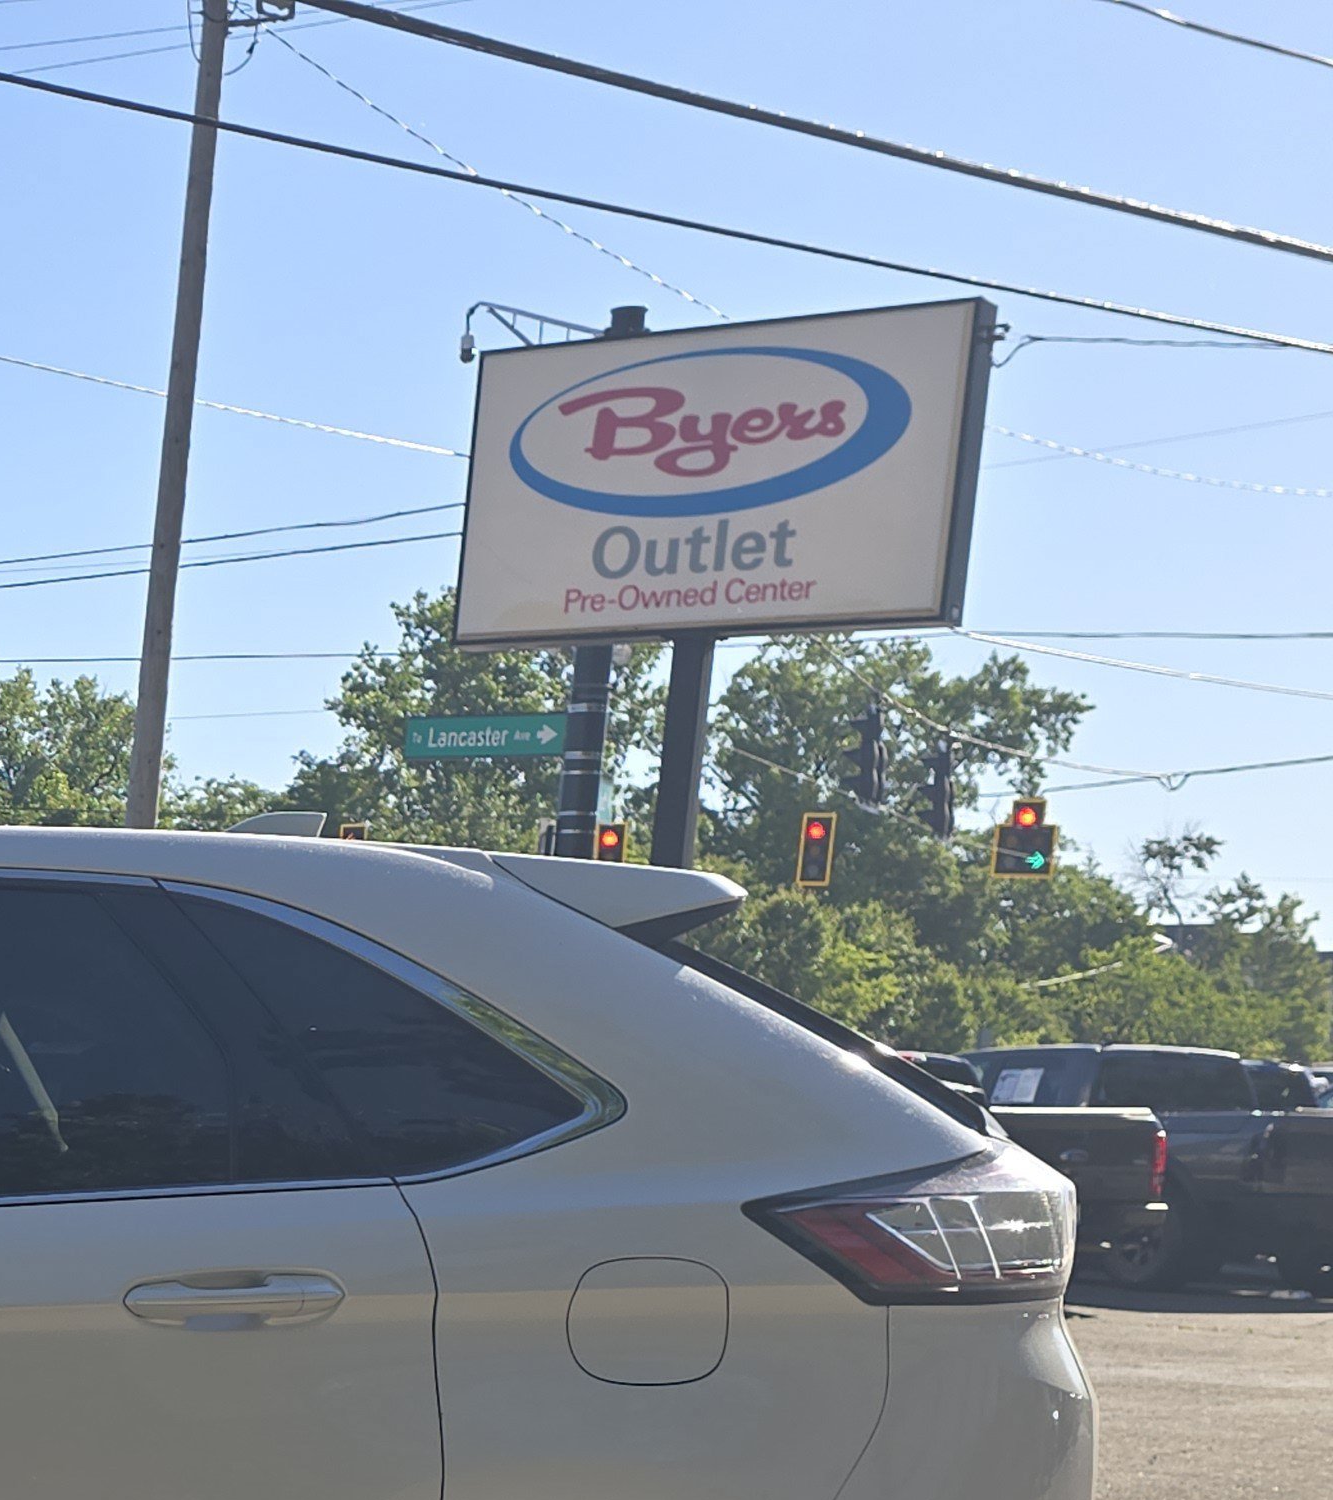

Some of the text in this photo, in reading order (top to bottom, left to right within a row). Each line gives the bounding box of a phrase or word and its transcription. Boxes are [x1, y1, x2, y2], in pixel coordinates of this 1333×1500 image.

[558, 387, 846, 477] Byers
[592, 519, 797, 579] Outlet
[563, 578, 817, 614] Pre-Owned Center
[428, 726, 508, 747] Lancaster
[513, 730, 531, 741] Ave
